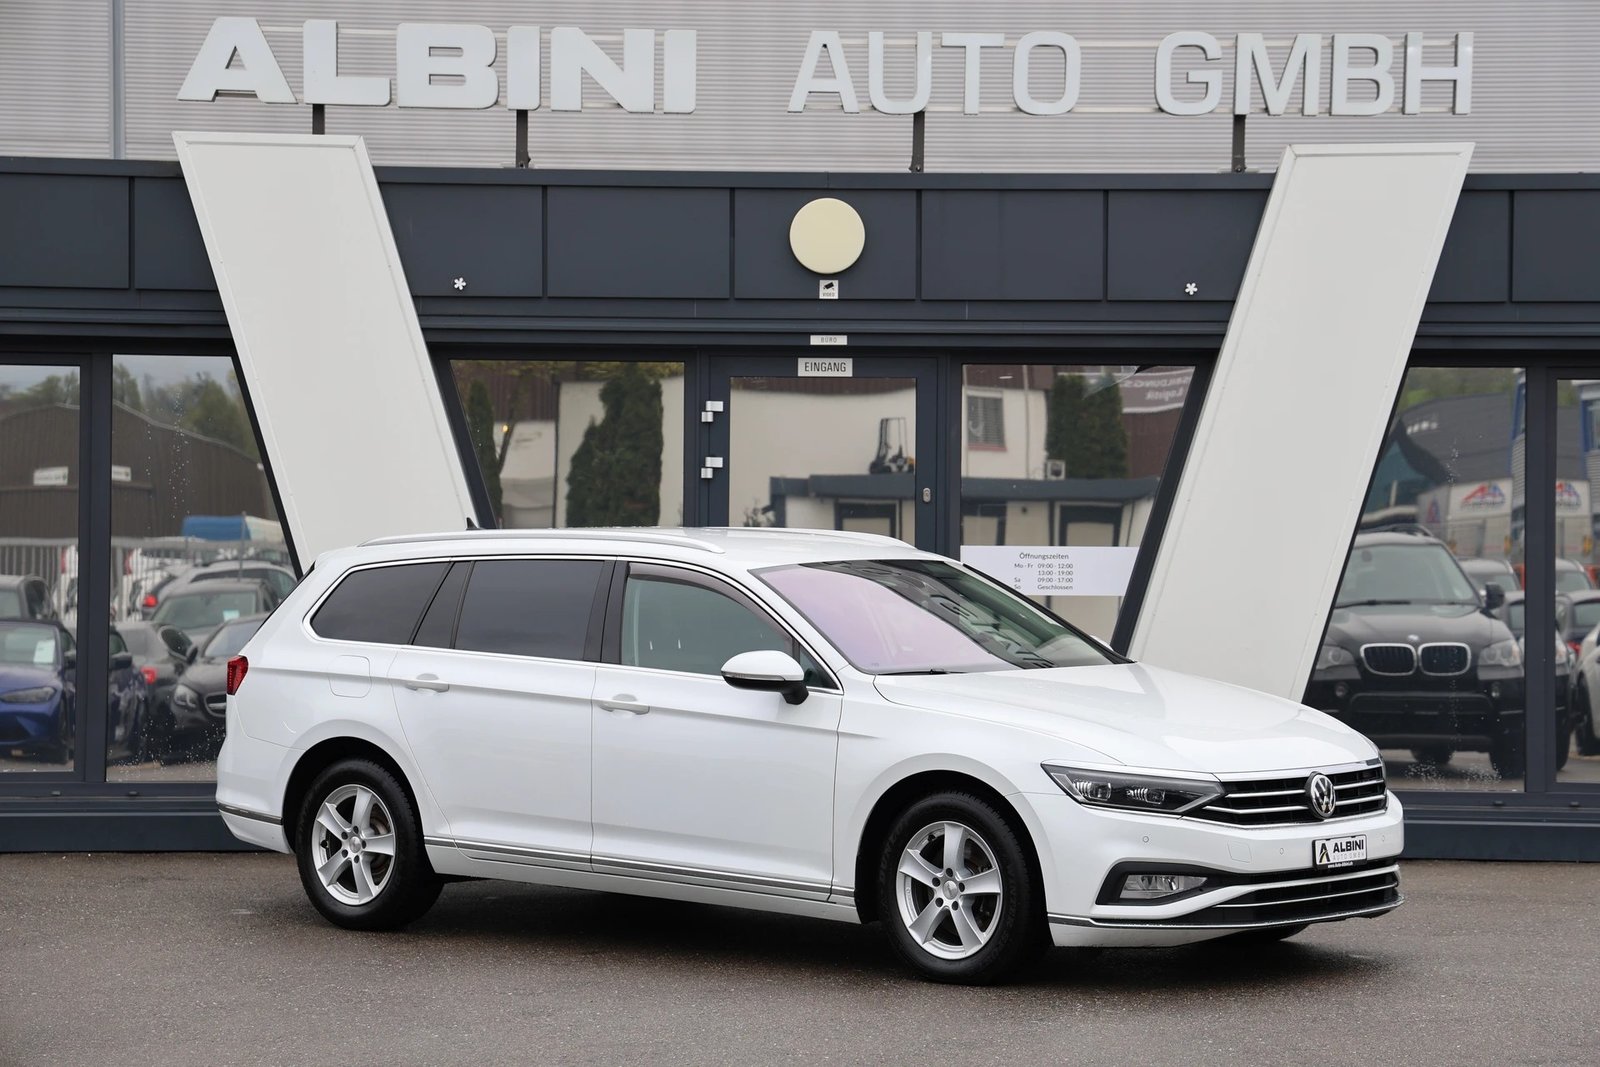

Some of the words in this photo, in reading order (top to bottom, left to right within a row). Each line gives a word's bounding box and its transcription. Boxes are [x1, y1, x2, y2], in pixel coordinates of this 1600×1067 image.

[176, 16, 698, 114] ALBINI
[787, 30, 1081, 116] AUTO
[1154, 31, 1475, 116] GMBH
[804, 362, 846, 372] EINGANG
[1019, 552, 1069, 560] Öffnungszeiten
[1333, 839, 1364, 853] ALBINI
